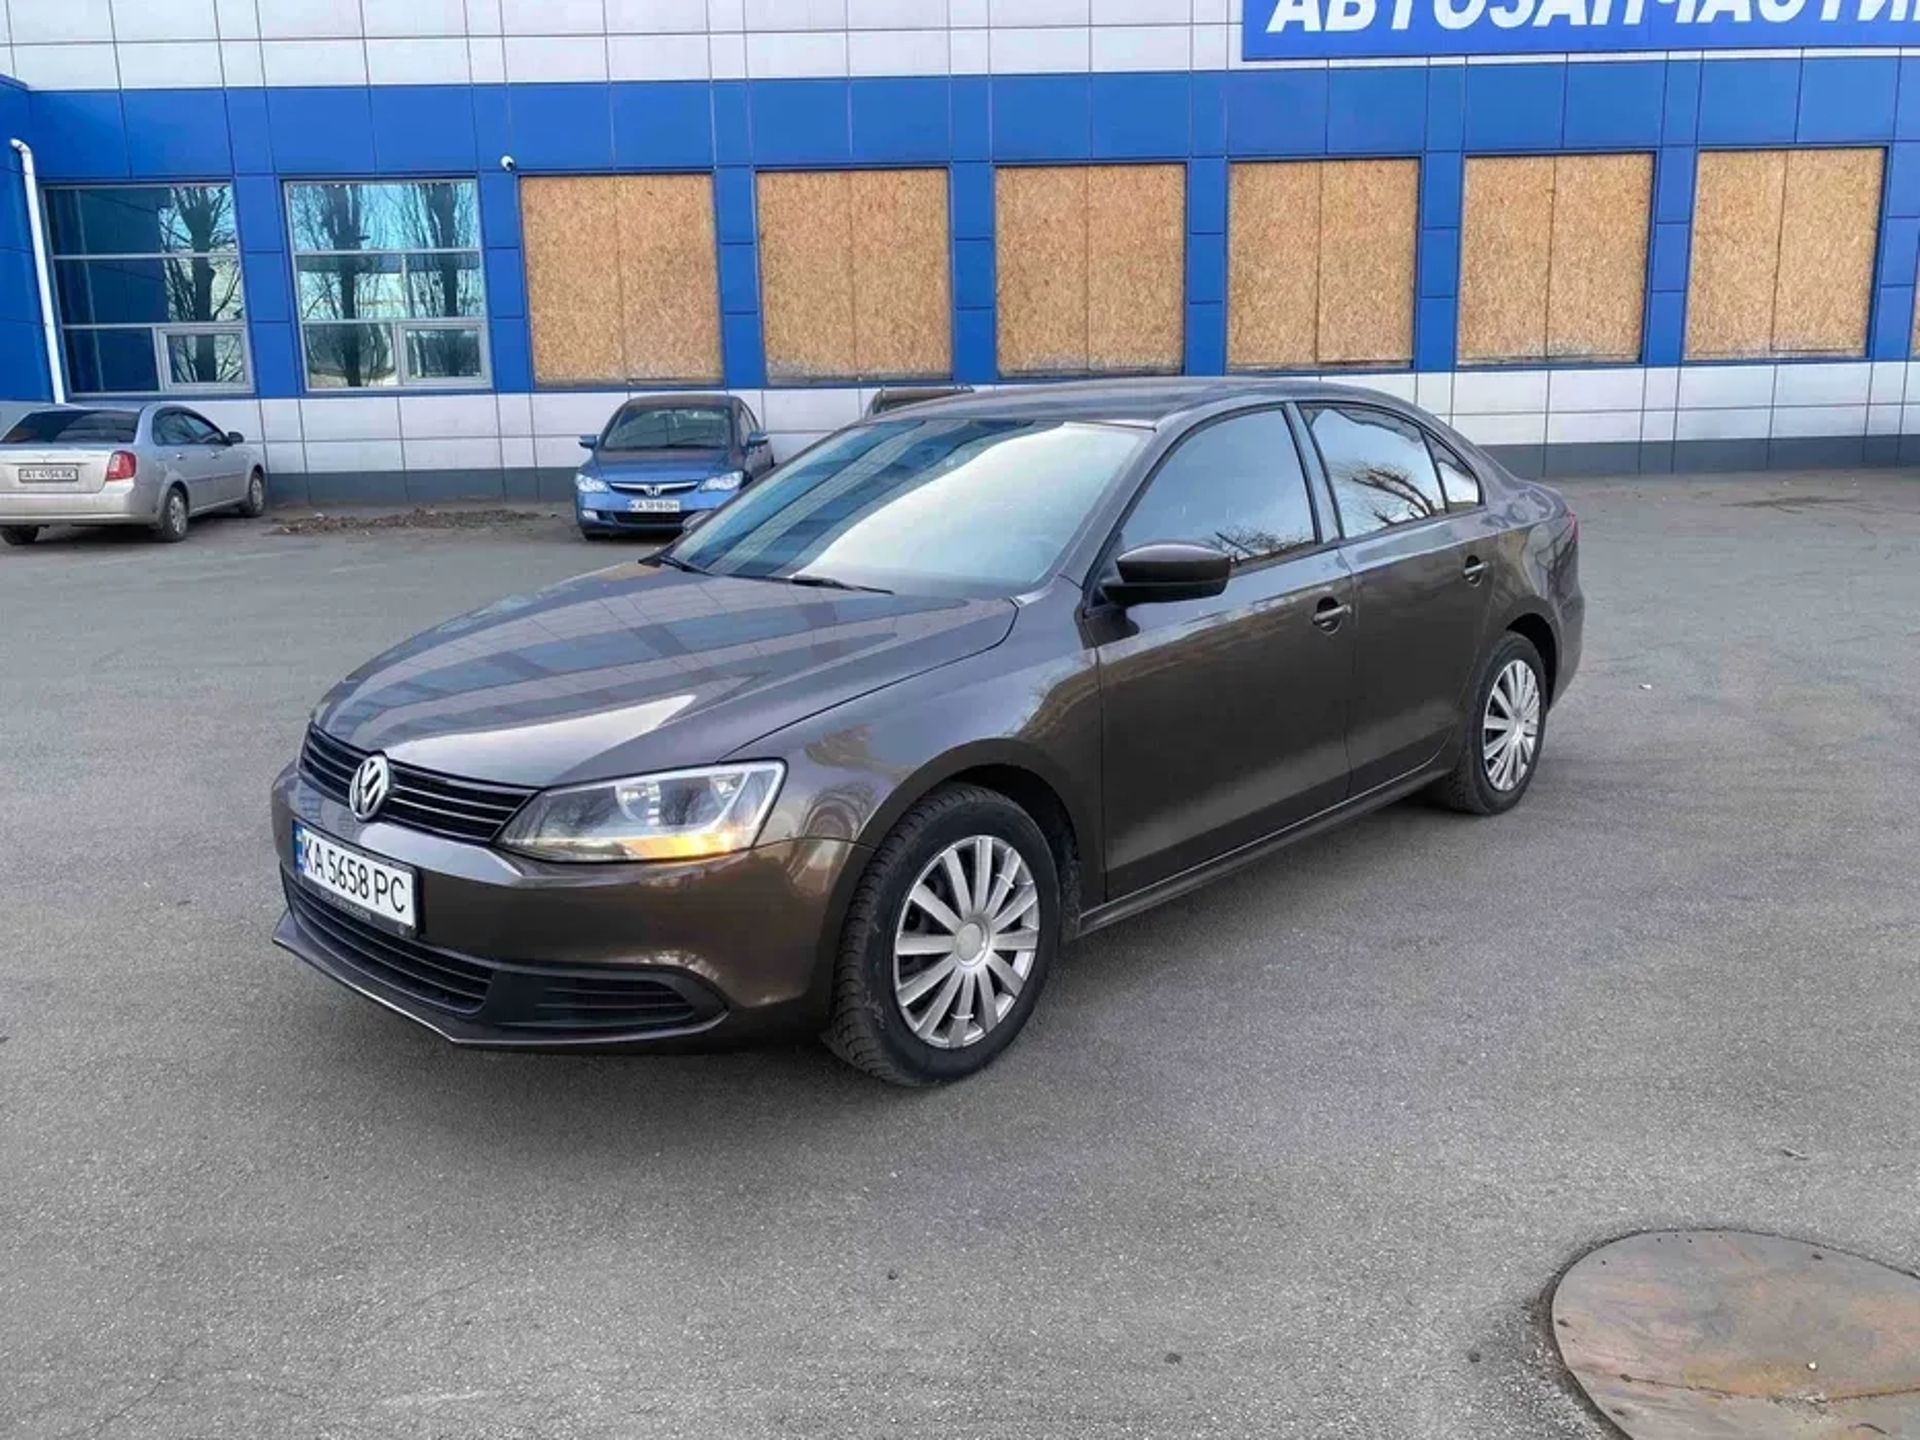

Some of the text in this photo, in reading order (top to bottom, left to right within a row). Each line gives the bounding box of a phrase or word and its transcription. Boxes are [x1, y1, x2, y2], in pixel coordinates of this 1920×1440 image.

[303, 838, 406, 913] KA 5658 PC
